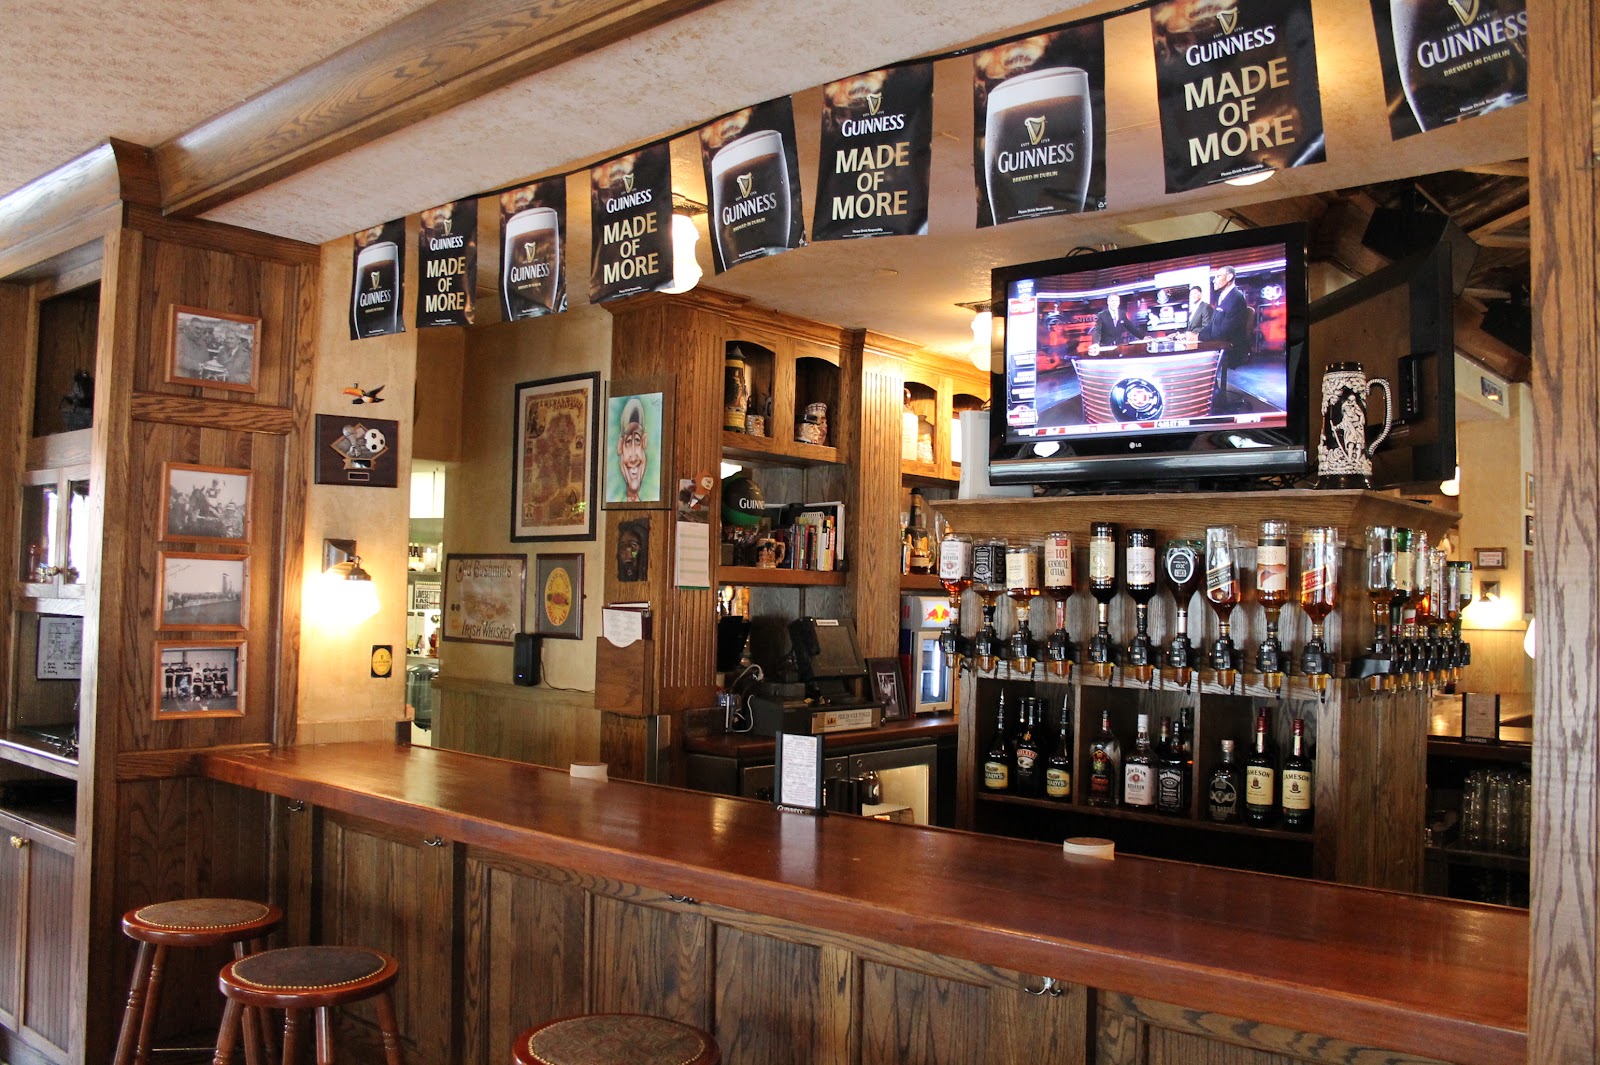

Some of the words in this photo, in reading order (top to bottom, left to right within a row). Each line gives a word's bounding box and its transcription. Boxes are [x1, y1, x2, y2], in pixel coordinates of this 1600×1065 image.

[1185, 26, 1276, 66] GUINNESS
[1416, 11, 1527, 68] GUINNESS
[1444, 62, 1472, 77] BREWED
[1474, 58, 1482, 66] IN
[1484, 49, 1510, 64] DUBLIN
[1184, 56, 1290, 112] MADE
[1218, 96, 1256, 127] OF
[842, 114, 904, 137] GUINNESS
[1188, 114, 1295, 167] MORE
[836, 142, 910, 174] MADE
[998, 143, 1074, 173] GUINNESS
[856, 171, 884, 192] OF
[1012, 175, 1033, 183] BREWED
[606, 189, 652, 213] GUINNESS
[722, 193, 777, 226] GUINNESS
[832, 190, 908, 221] MORE
[604, 212, 657, 245] MADE
[430, 236, 464, 251] GUINNESS
[620, 238, 640, 258] OF
[427, 256, 465, 278] MADE
[510, 263, 550, 283] GUINNESS
[604, 252, 659, 284] MORE
[438, 278, 452, 292] OF
[360, 290, 391, 307] GUINNESS
[426, 292, 464, 313] MORE
[739, 498, 765, 510] GUINNE
[1048, 560, 1068, 568] TURKEY
[1056, 549, 1068, 558] 101
[456, 560, 472, 582] Old
[474, 560, 511, 579] Bushmills
[1050, 568, 1065, 576] WILD
[462, 620, 481, 638] IRISH
[482, 620, 514, 640] WHISKEY
